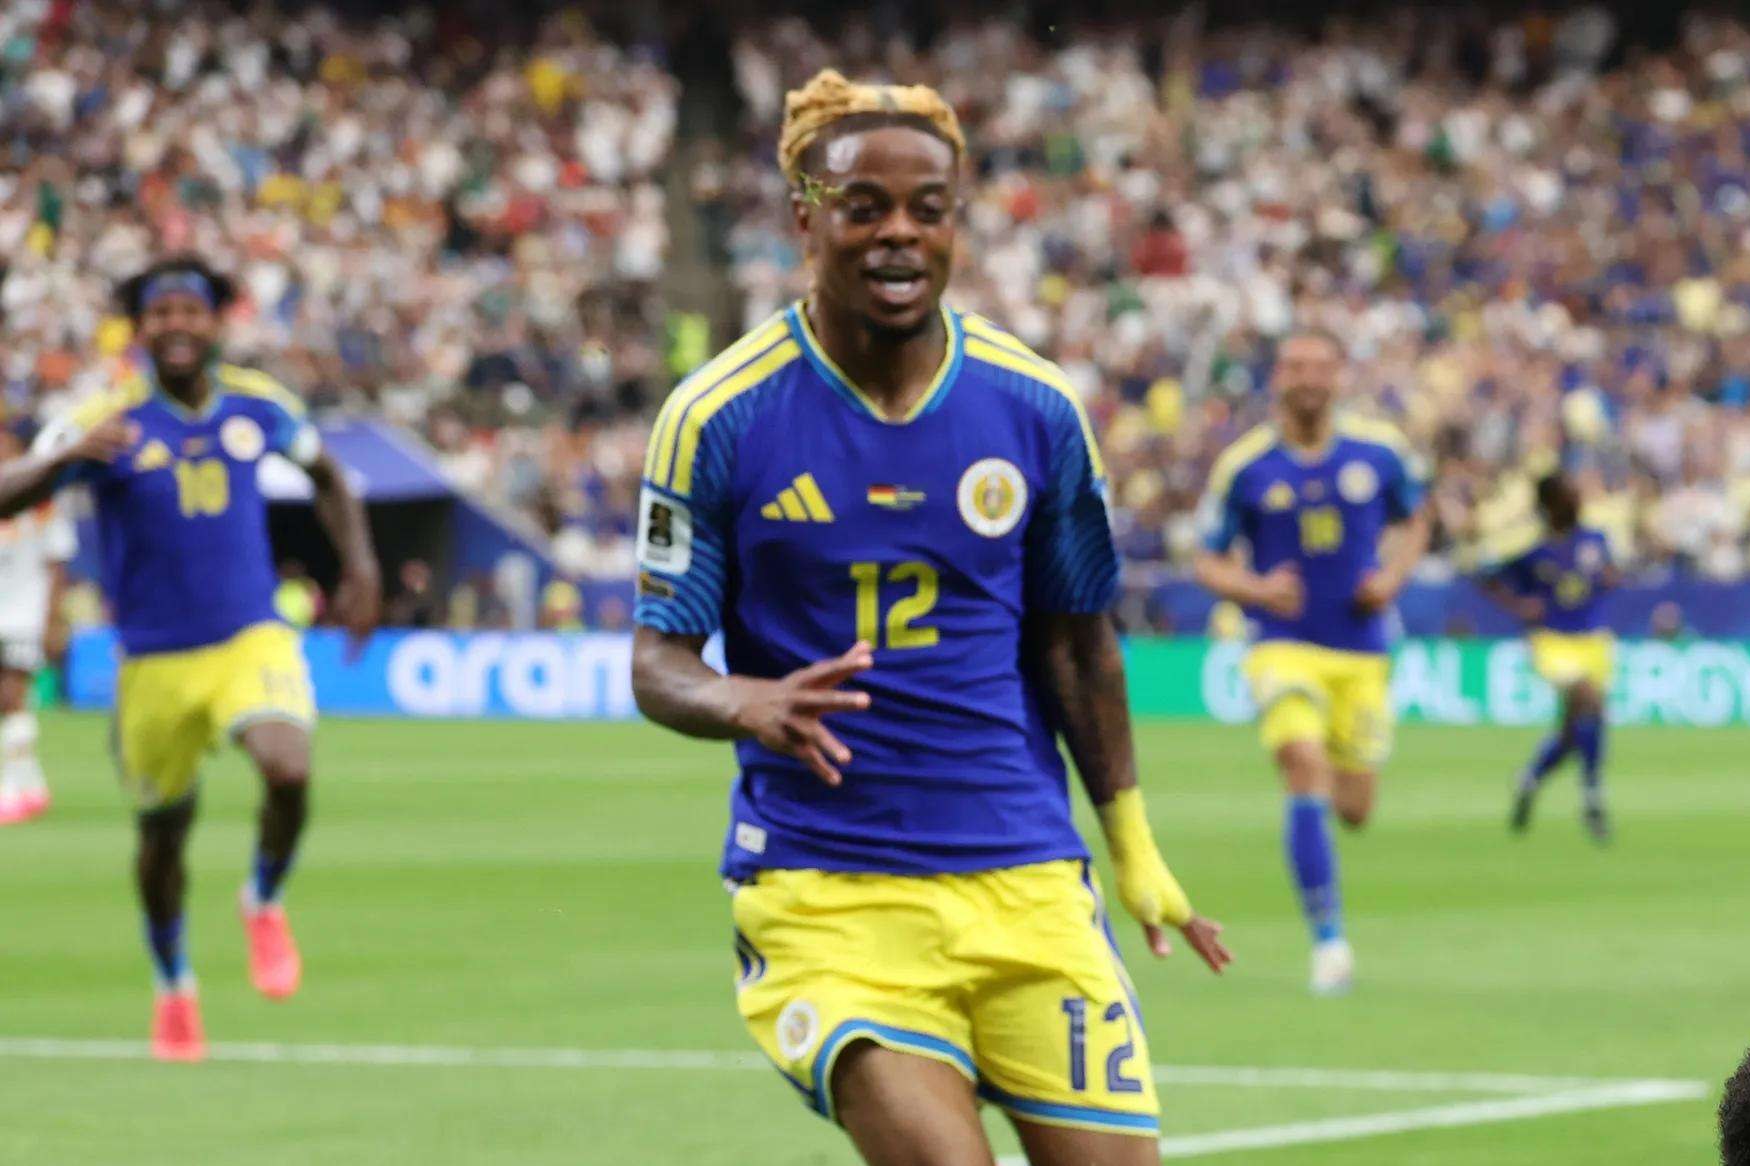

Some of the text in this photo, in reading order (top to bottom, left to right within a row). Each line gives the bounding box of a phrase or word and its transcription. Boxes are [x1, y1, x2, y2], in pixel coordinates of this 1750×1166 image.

[850, 561, 939, 649] 12
[387, 631, 637, 717] aram
[1061, 997, 1143, 1092] 12
